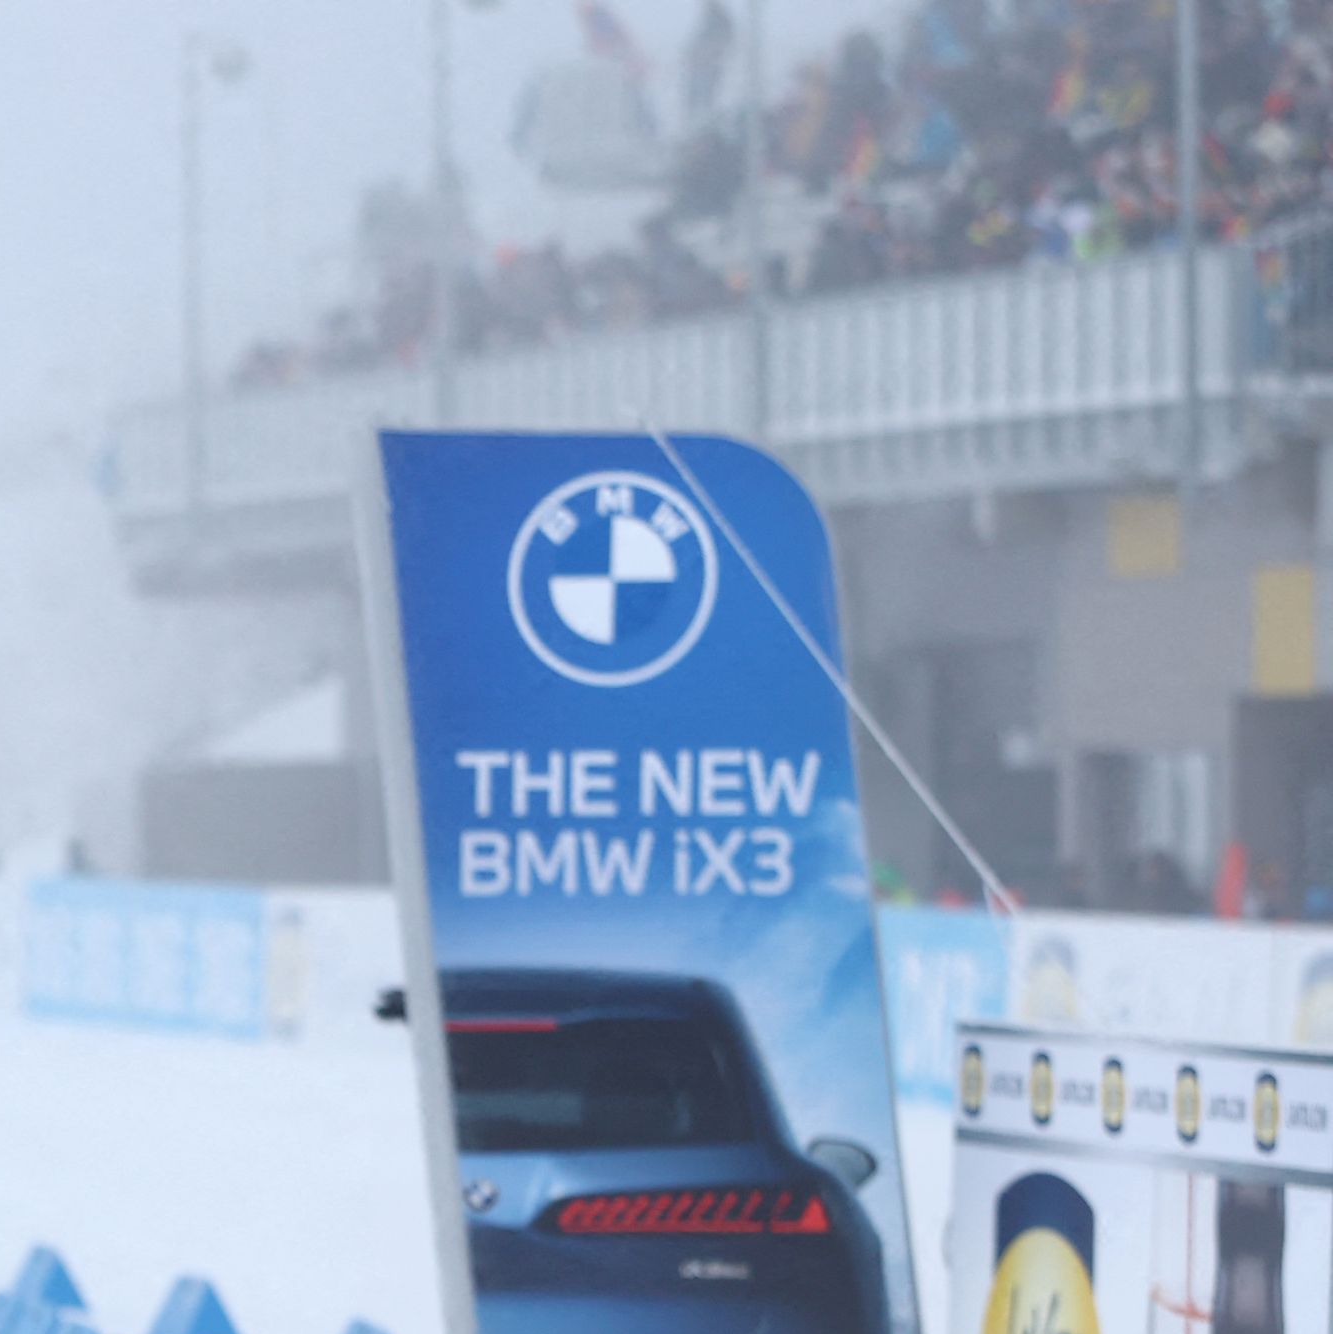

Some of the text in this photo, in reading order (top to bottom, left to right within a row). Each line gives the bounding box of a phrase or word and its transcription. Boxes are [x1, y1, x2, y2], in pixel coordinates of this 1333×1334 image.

[456, 750, 821, 818] THE NEW
[459, 829, 794, 897] BMW iX3
